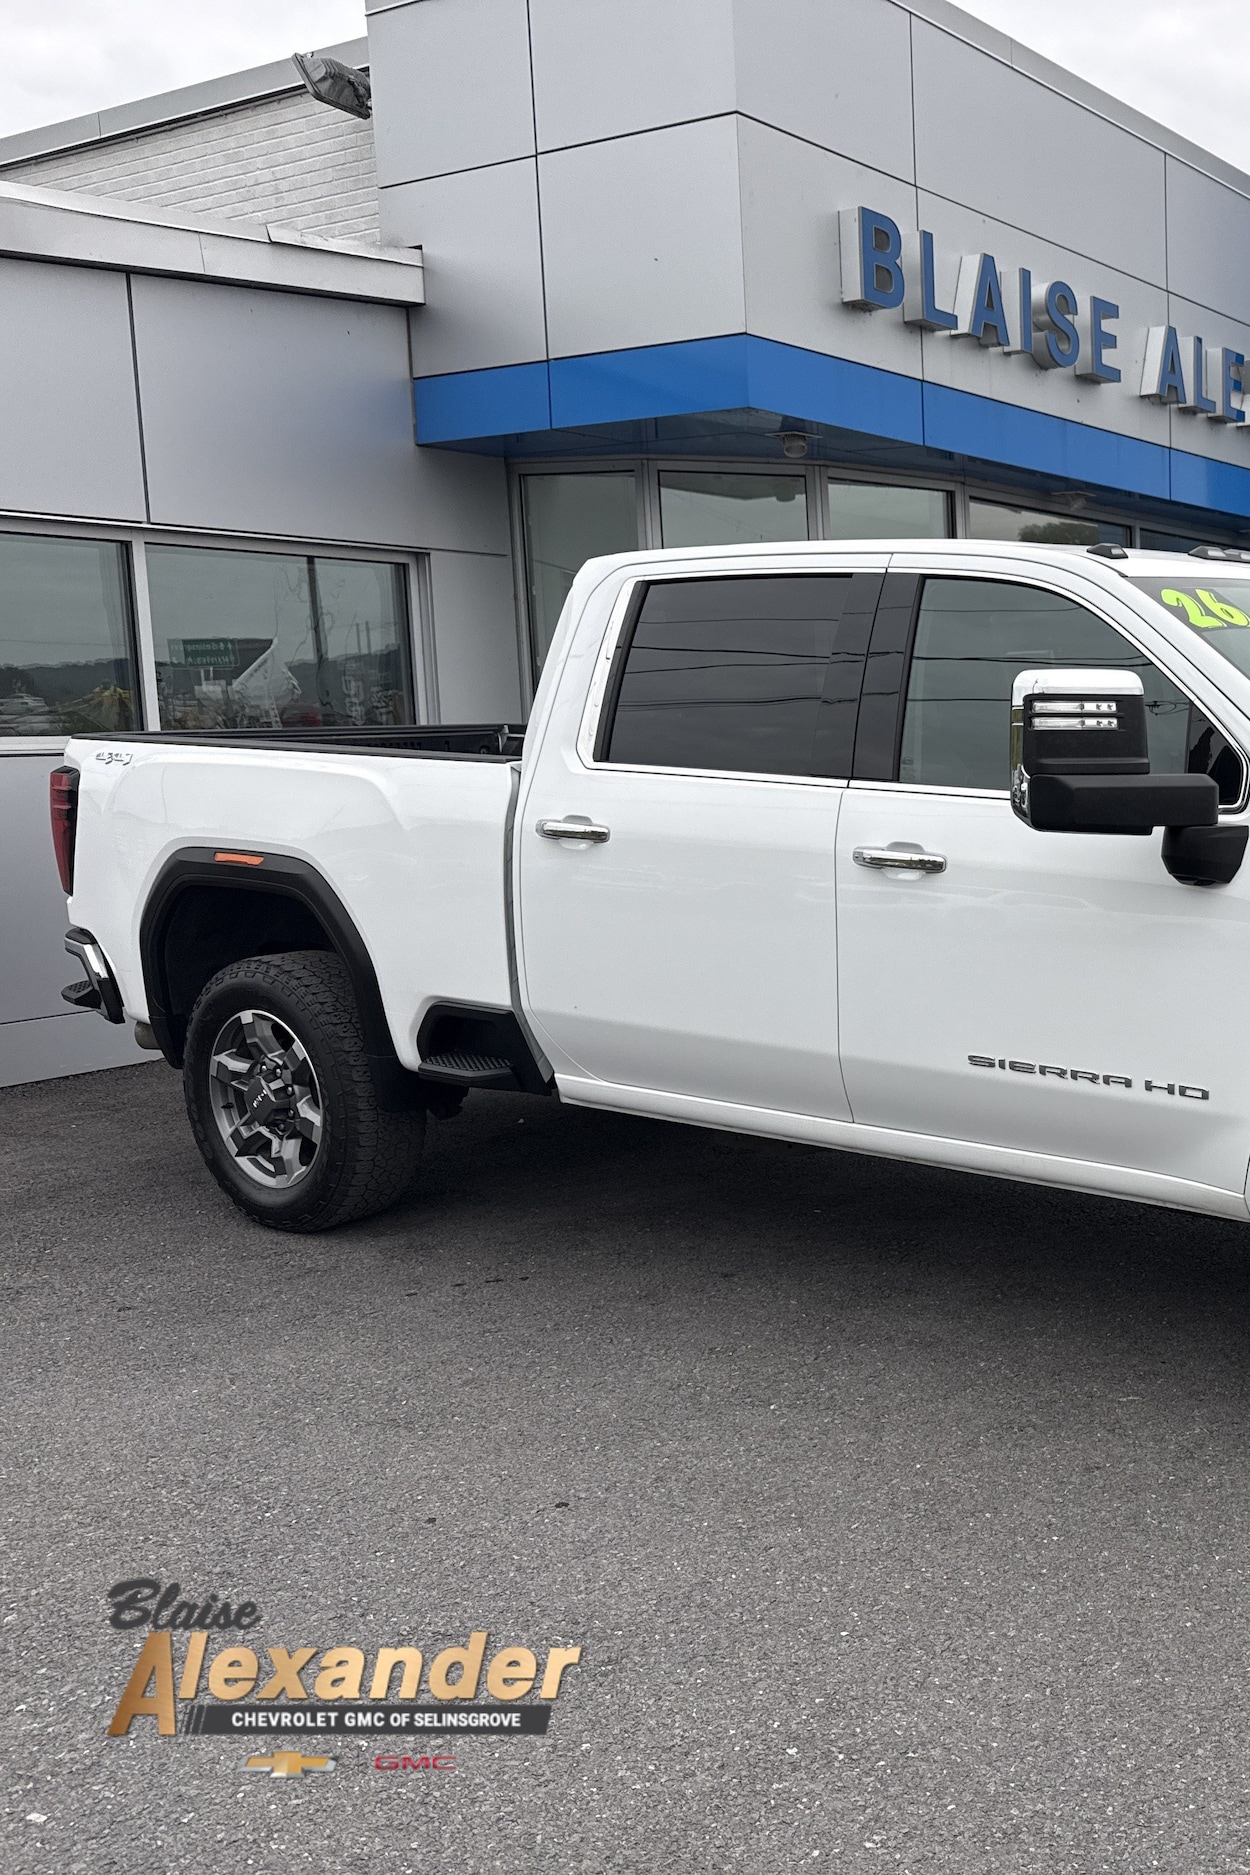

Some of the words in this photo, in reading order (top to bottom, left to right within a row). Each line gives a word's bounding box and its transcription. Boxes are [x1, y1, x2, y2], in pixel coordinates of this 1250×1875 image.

[839, 205, 1122, 384] BLAISE
[967, 1053, 1132, 1088] SIERRA
[1144, 1078, 1210, 1100] HD
